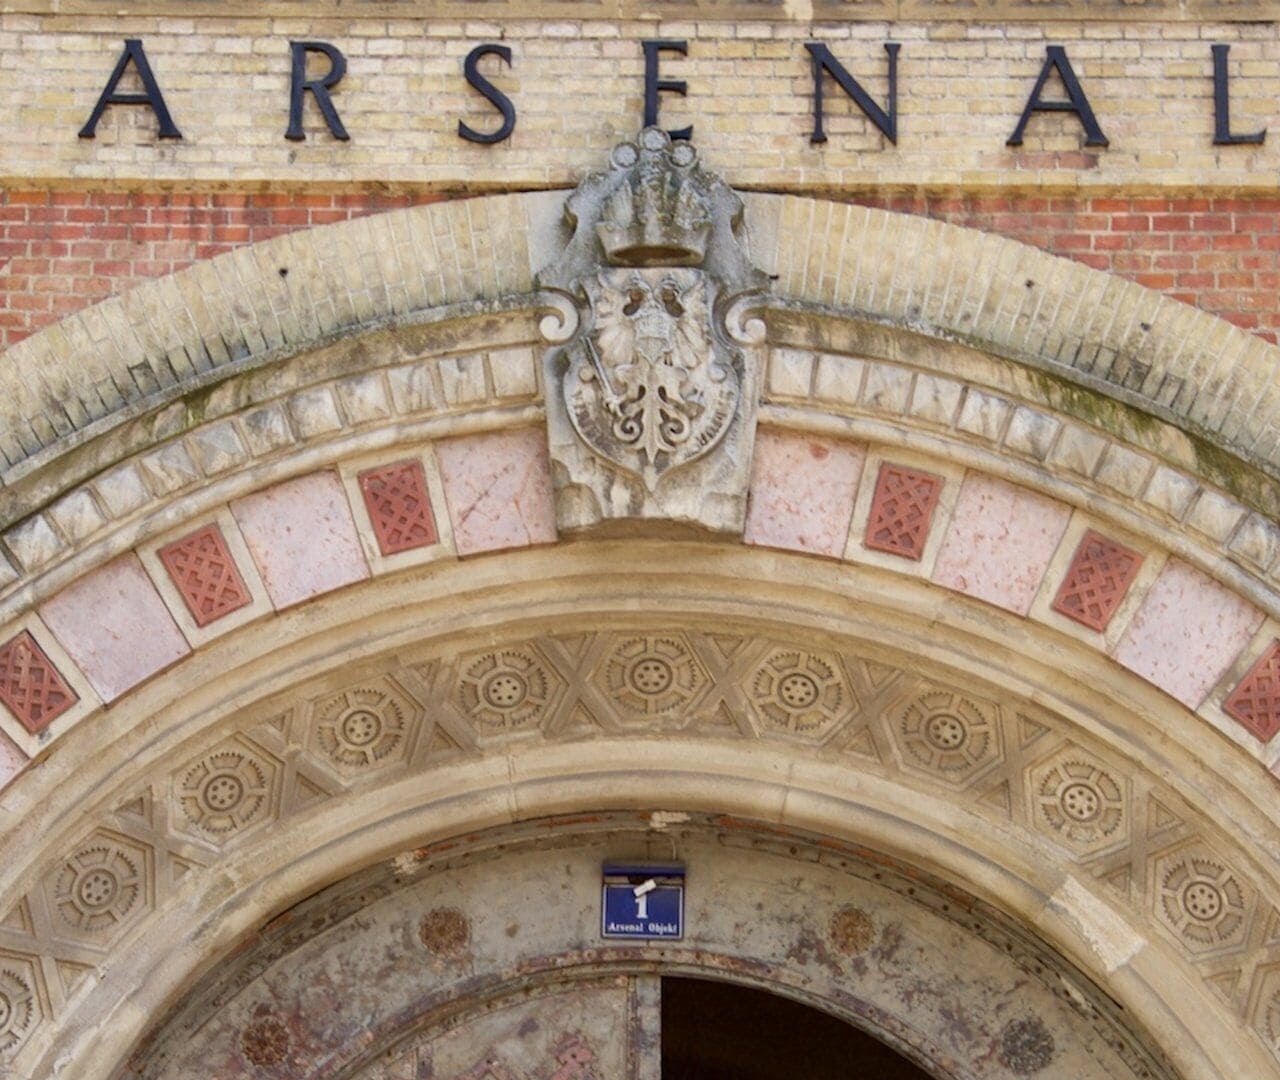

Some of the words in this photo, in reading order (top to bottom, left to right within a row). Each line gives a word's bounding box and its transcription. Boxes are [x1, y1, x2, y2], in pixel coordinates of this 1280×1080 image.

[78, 39, 1267, 146] ARSENAL
[635, 893, 648, 919] 1
[608, 922, 644, 933] Arsenal
[648, 922, 677, 935] Objekt
